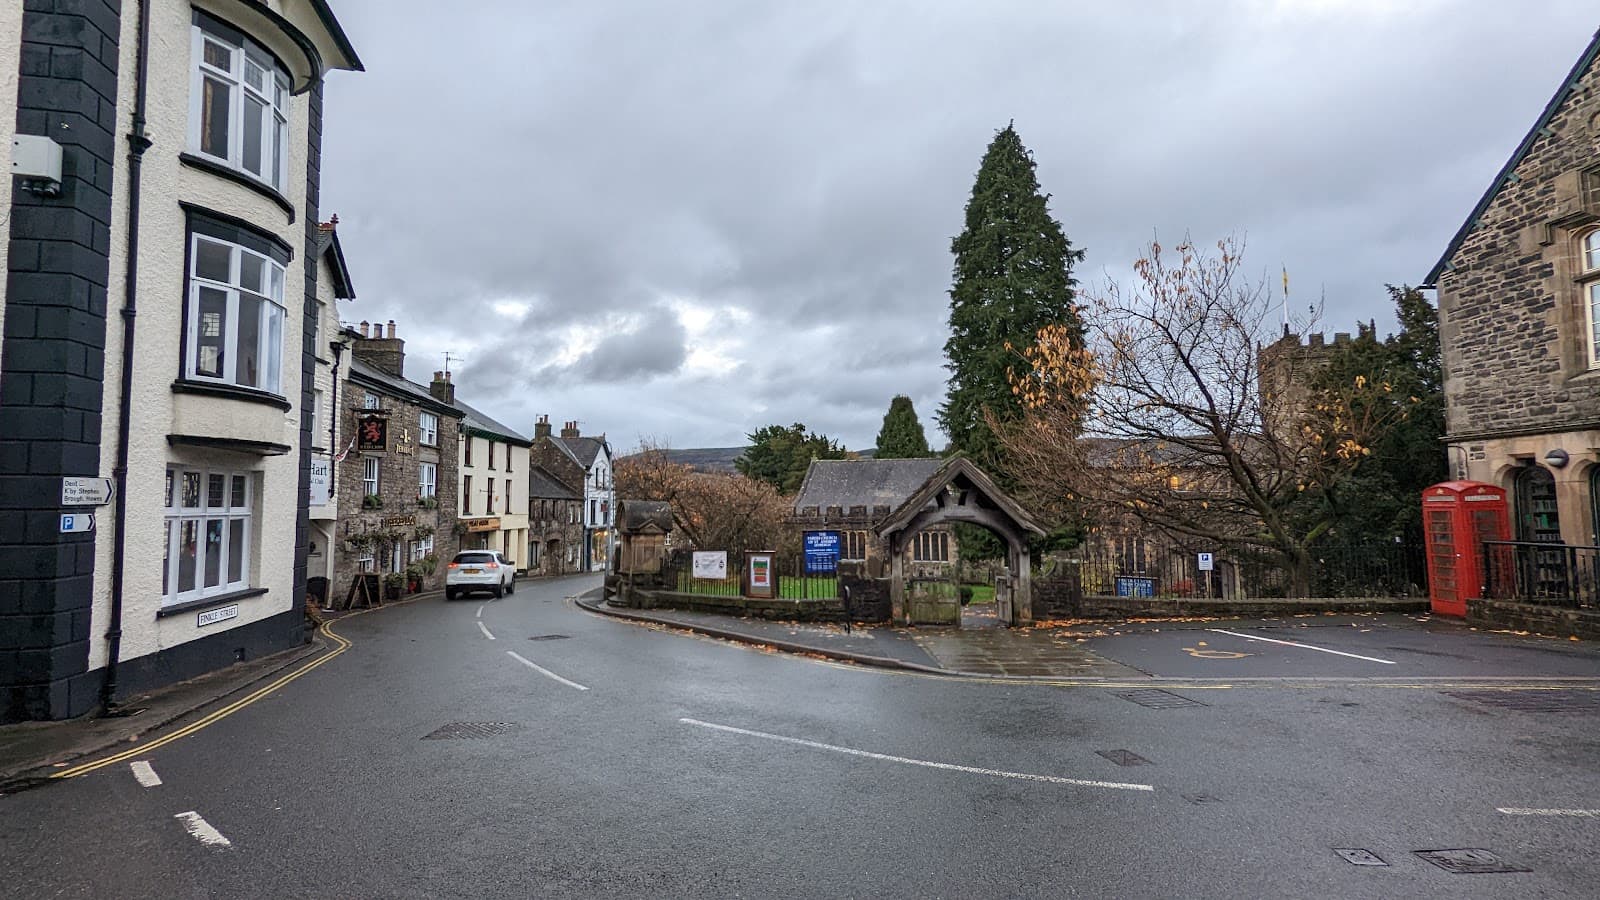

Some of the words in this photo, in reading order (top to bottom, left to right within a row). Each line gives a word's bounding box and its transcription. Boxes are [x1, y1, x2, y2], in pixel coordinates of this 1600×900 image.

[64, 517, 73, 529] P
[200, 611, 218, 624] FINKLE
[219, 607, 236, 619] STREET
